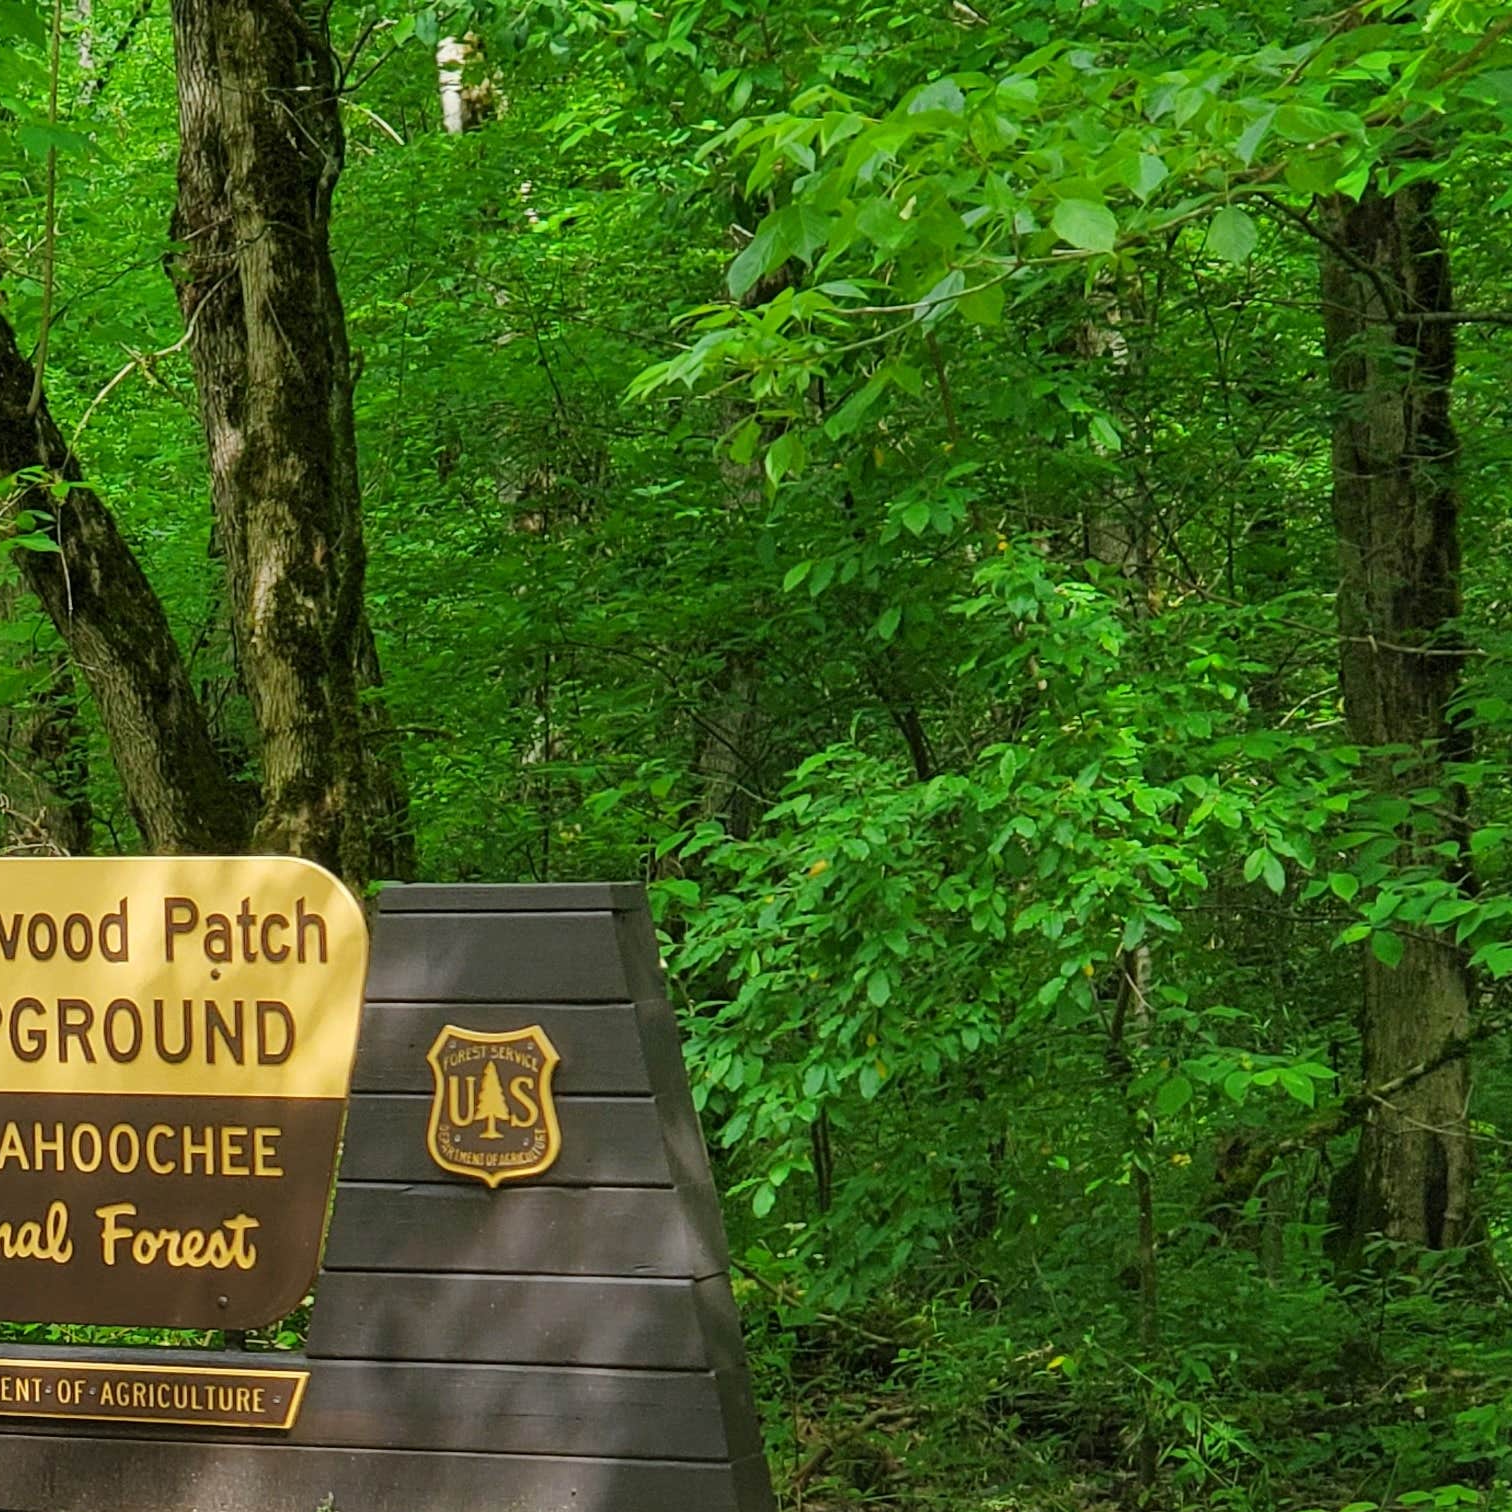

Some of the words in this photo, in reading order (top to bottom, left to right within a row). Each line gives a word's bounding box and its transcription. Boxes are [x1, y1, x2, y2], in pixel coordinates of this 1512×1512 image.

[164, 896, 328, 964] Patch
[443, 1046, 486, 1071] FOREST
[490, 1046, 539, 1073] SERVICE
[95, 1203, 260, 1270] Forest
[57, 1379, 87, 1405] OF
[100, 1381, 266, 1413] AGRICULTURE
